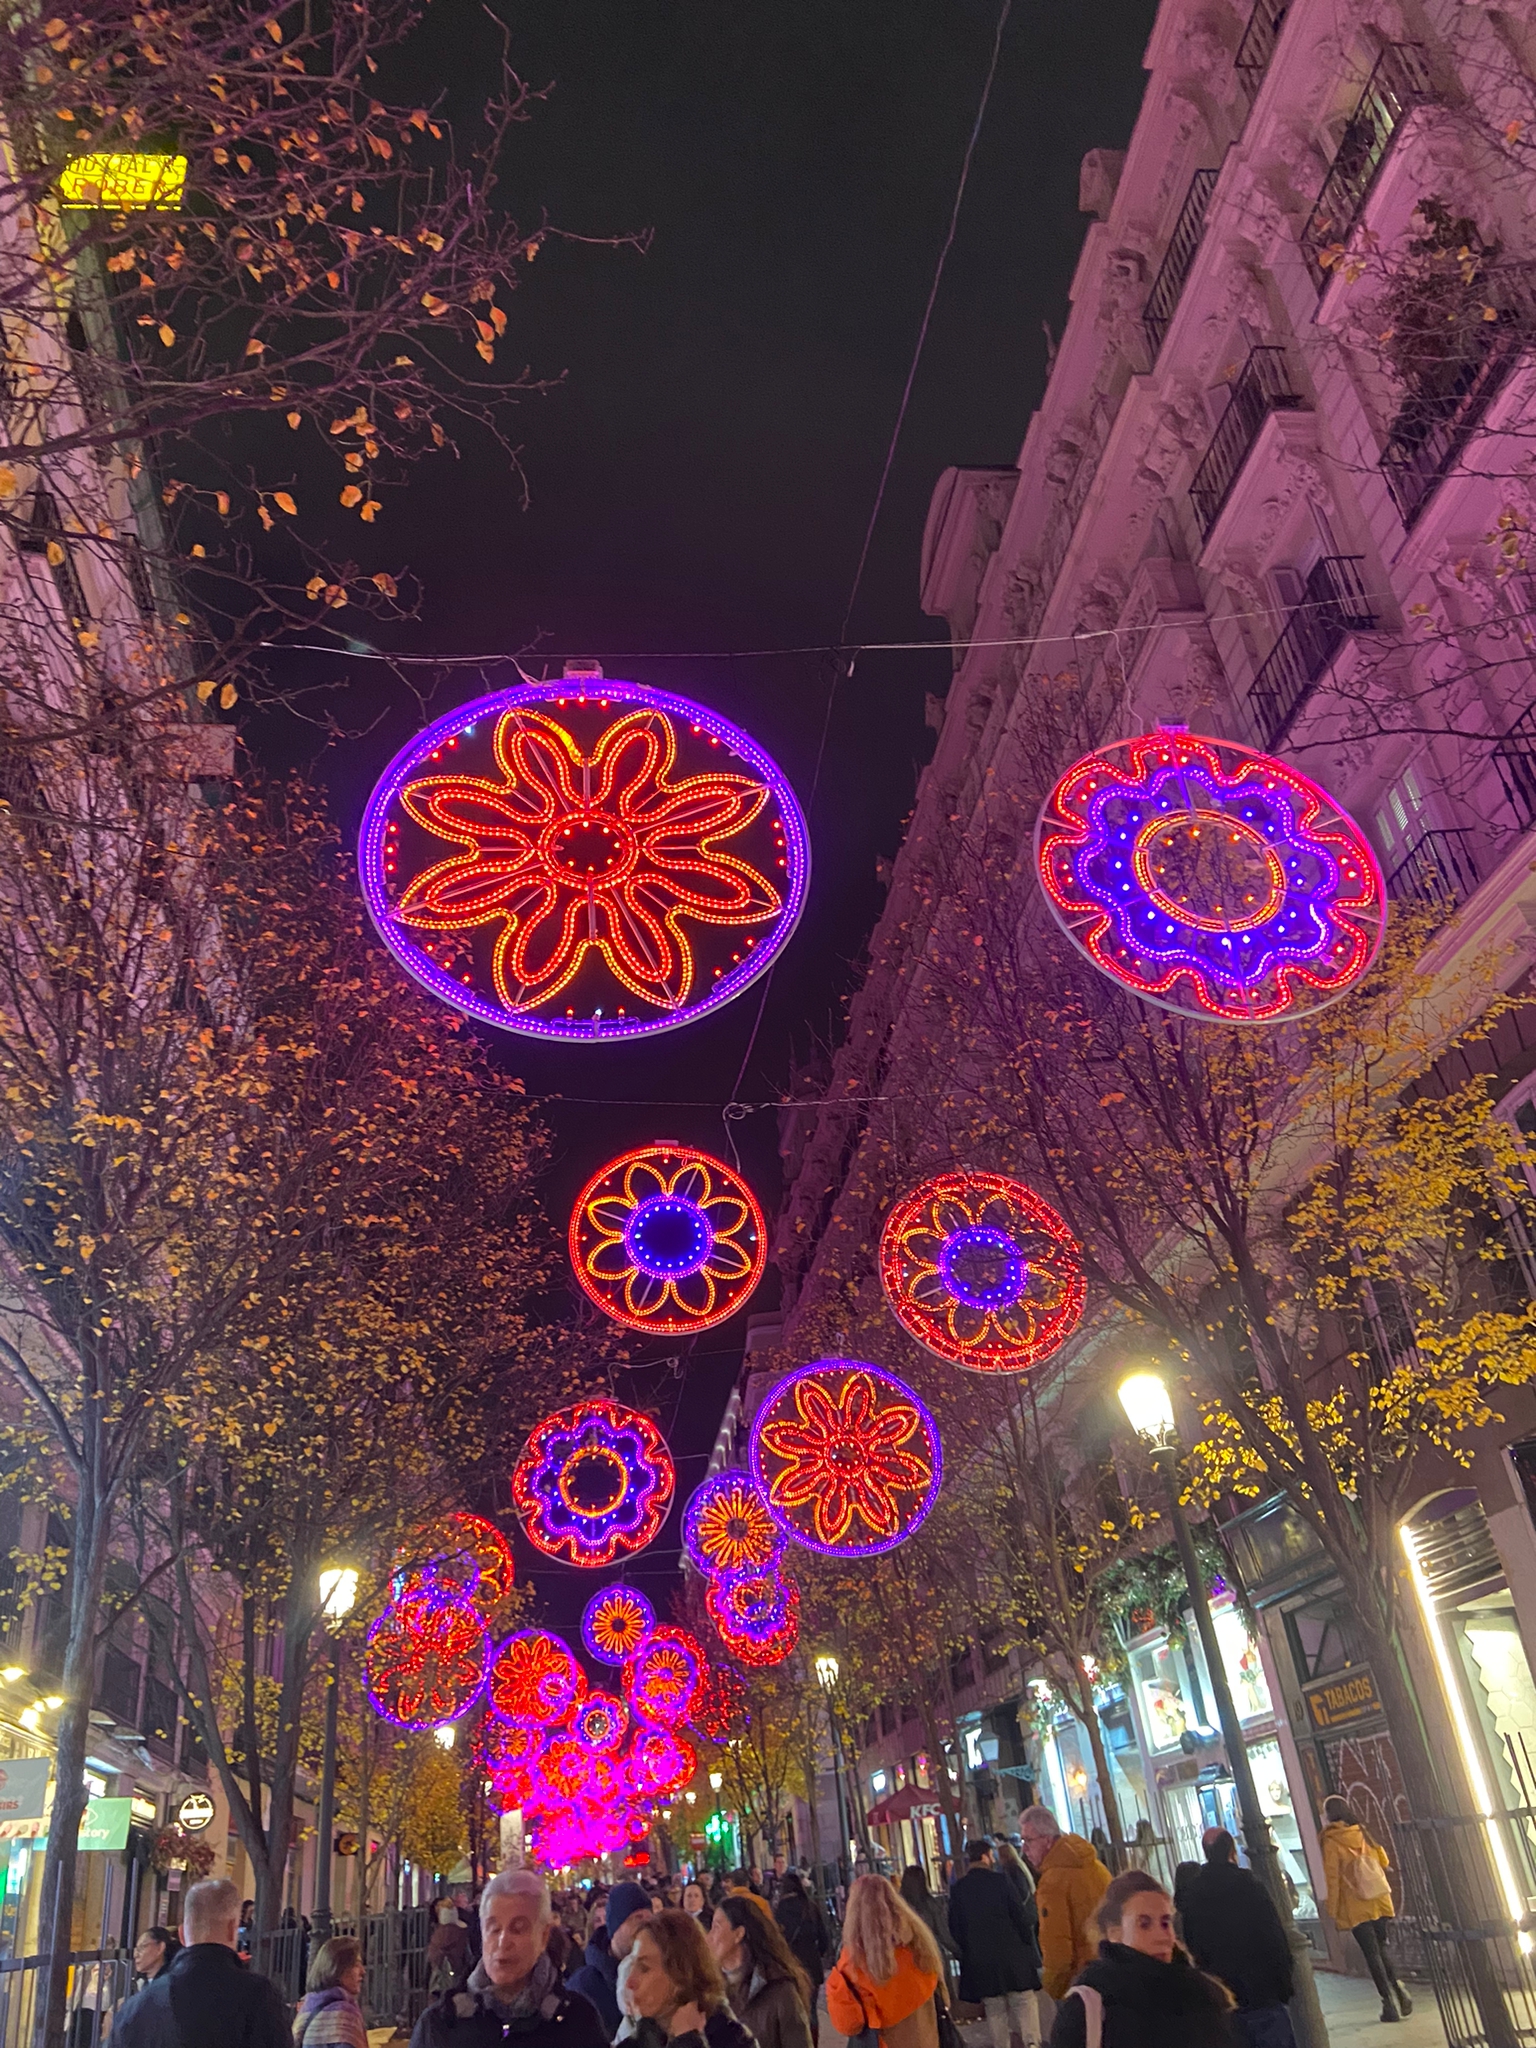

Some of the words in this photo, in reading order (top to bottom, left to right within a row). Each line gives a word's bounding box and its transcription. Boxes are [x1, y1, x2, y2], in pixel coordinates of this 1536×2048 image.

[69, 154, 151, 173] HOSTAL
[1324, 1677, 1372, 1709] TABACOS
[910, 1803, 941, 1819] KFC
